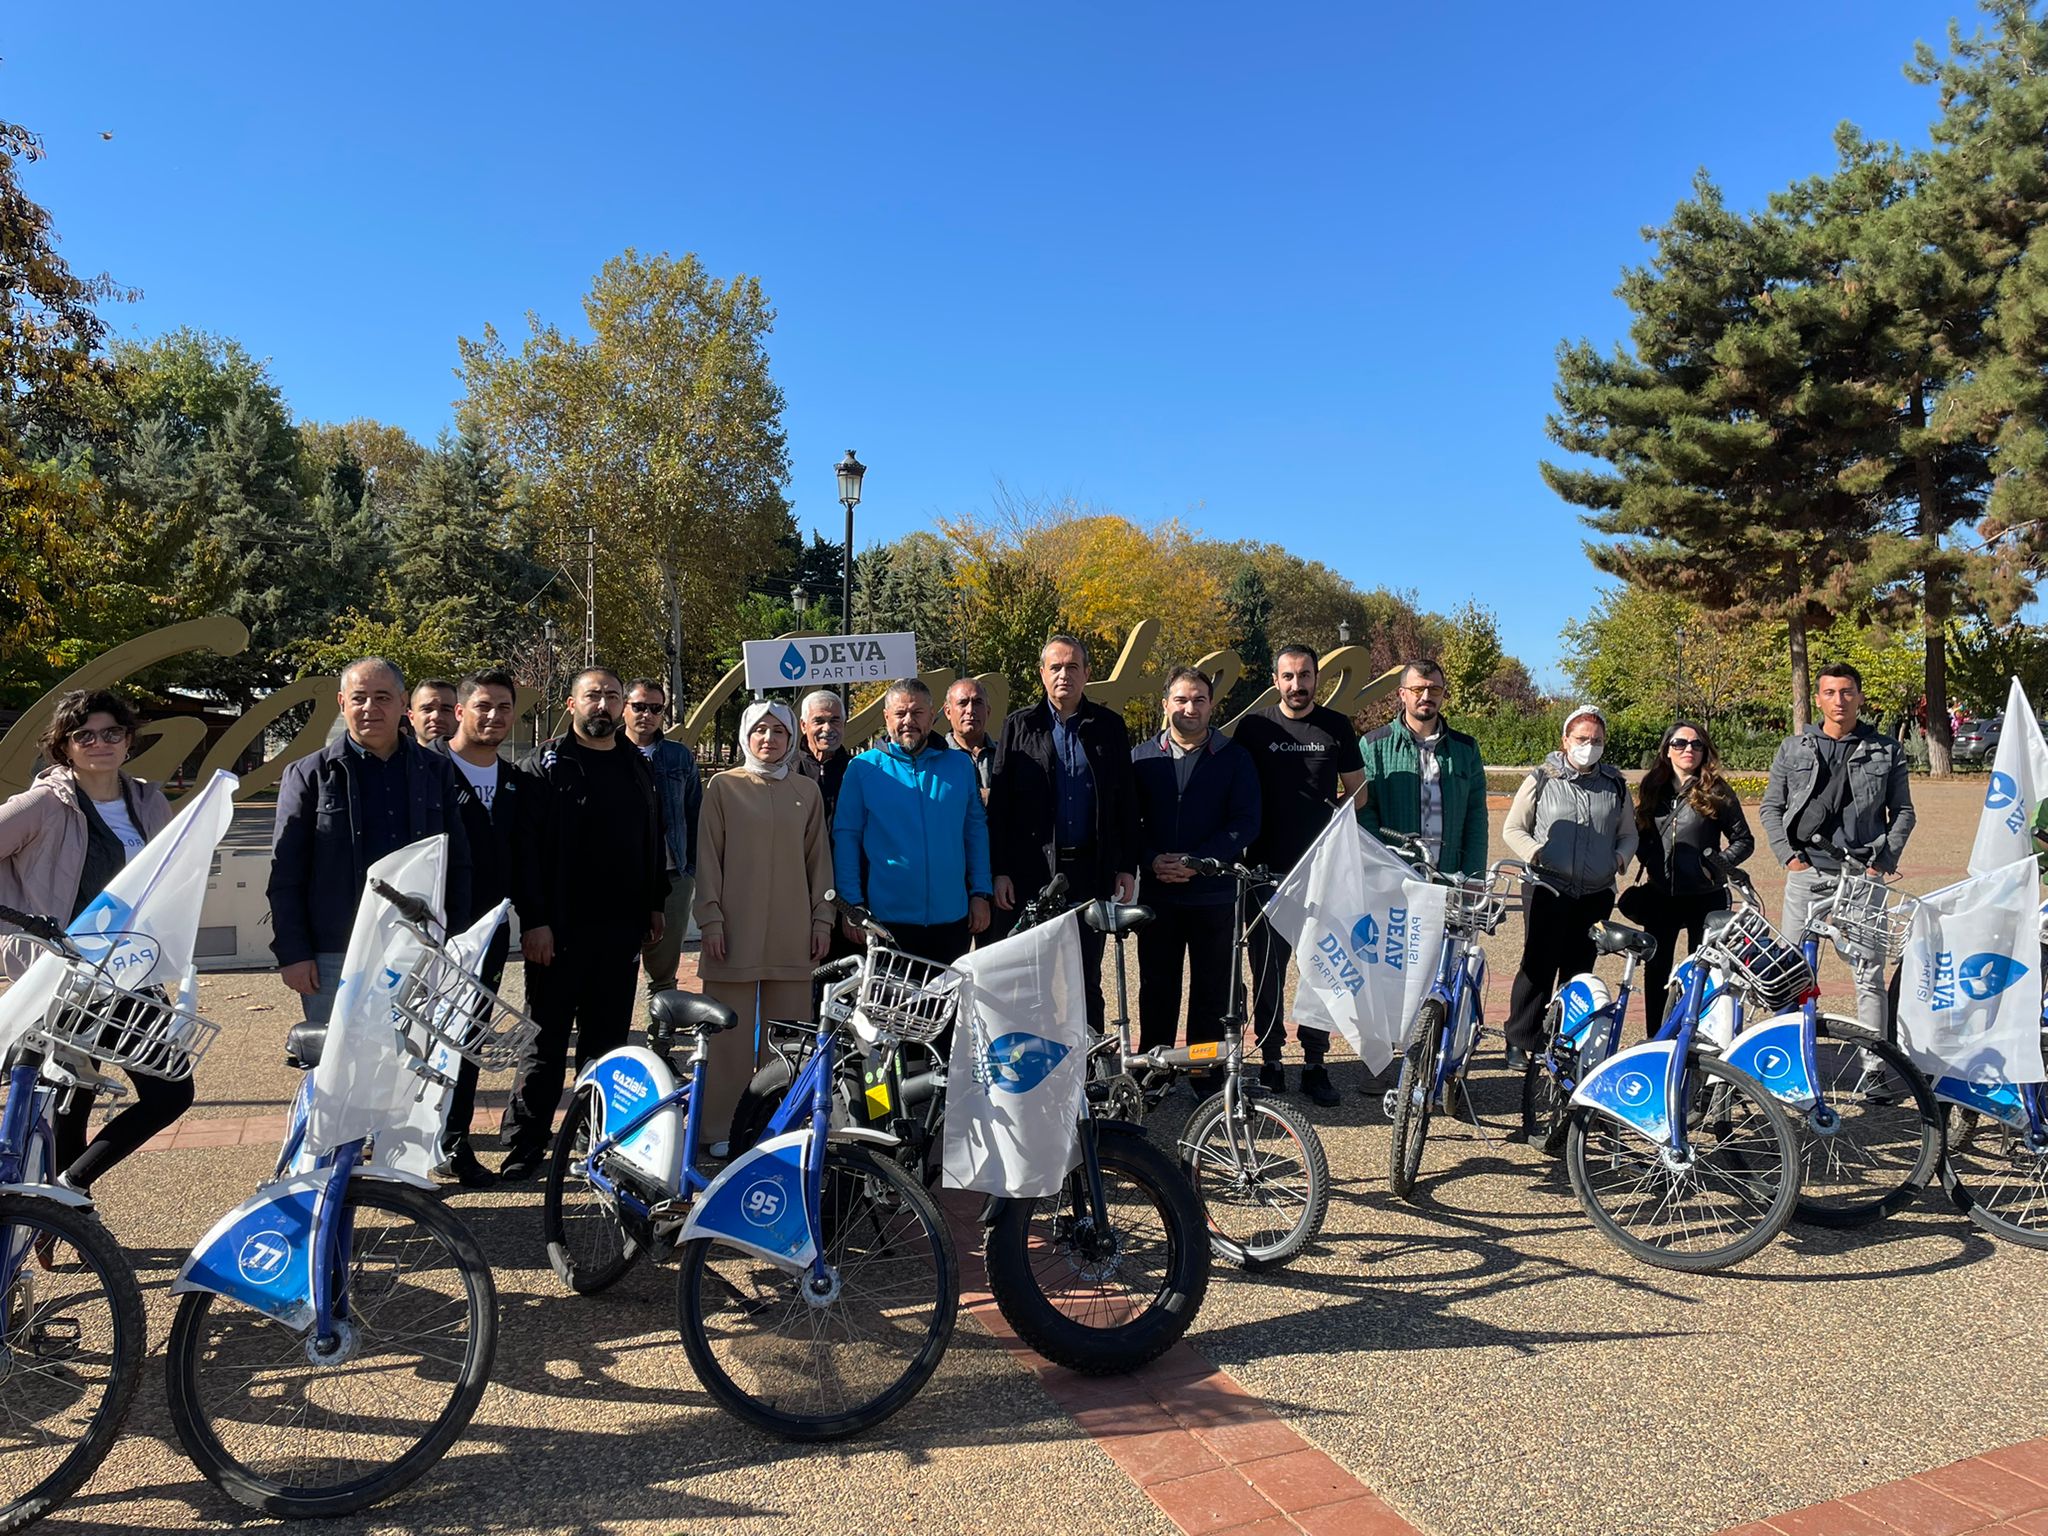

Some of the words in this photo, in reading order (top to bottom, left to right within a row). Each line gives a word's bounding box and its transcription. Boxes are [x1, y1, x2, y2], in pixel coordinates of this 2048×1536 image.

[810, 641, 886, 664] DEVA
[811, 661, 887, 679] PARTİSİ
[1280, 742, 1325, 751] Columbia
[1317, 933, 1365, 996] DEVA
[1916, 953, 1931, 1002] ARTİSİ
[1932, 951, 1956, 1011] DEVA
[1766, 1054, 1780, 1069] 7
[1625, 1081, 1642, 1097] 3
[749, 1190, 779, 1215] 95
[249, 1242, 283, 1270] 77
